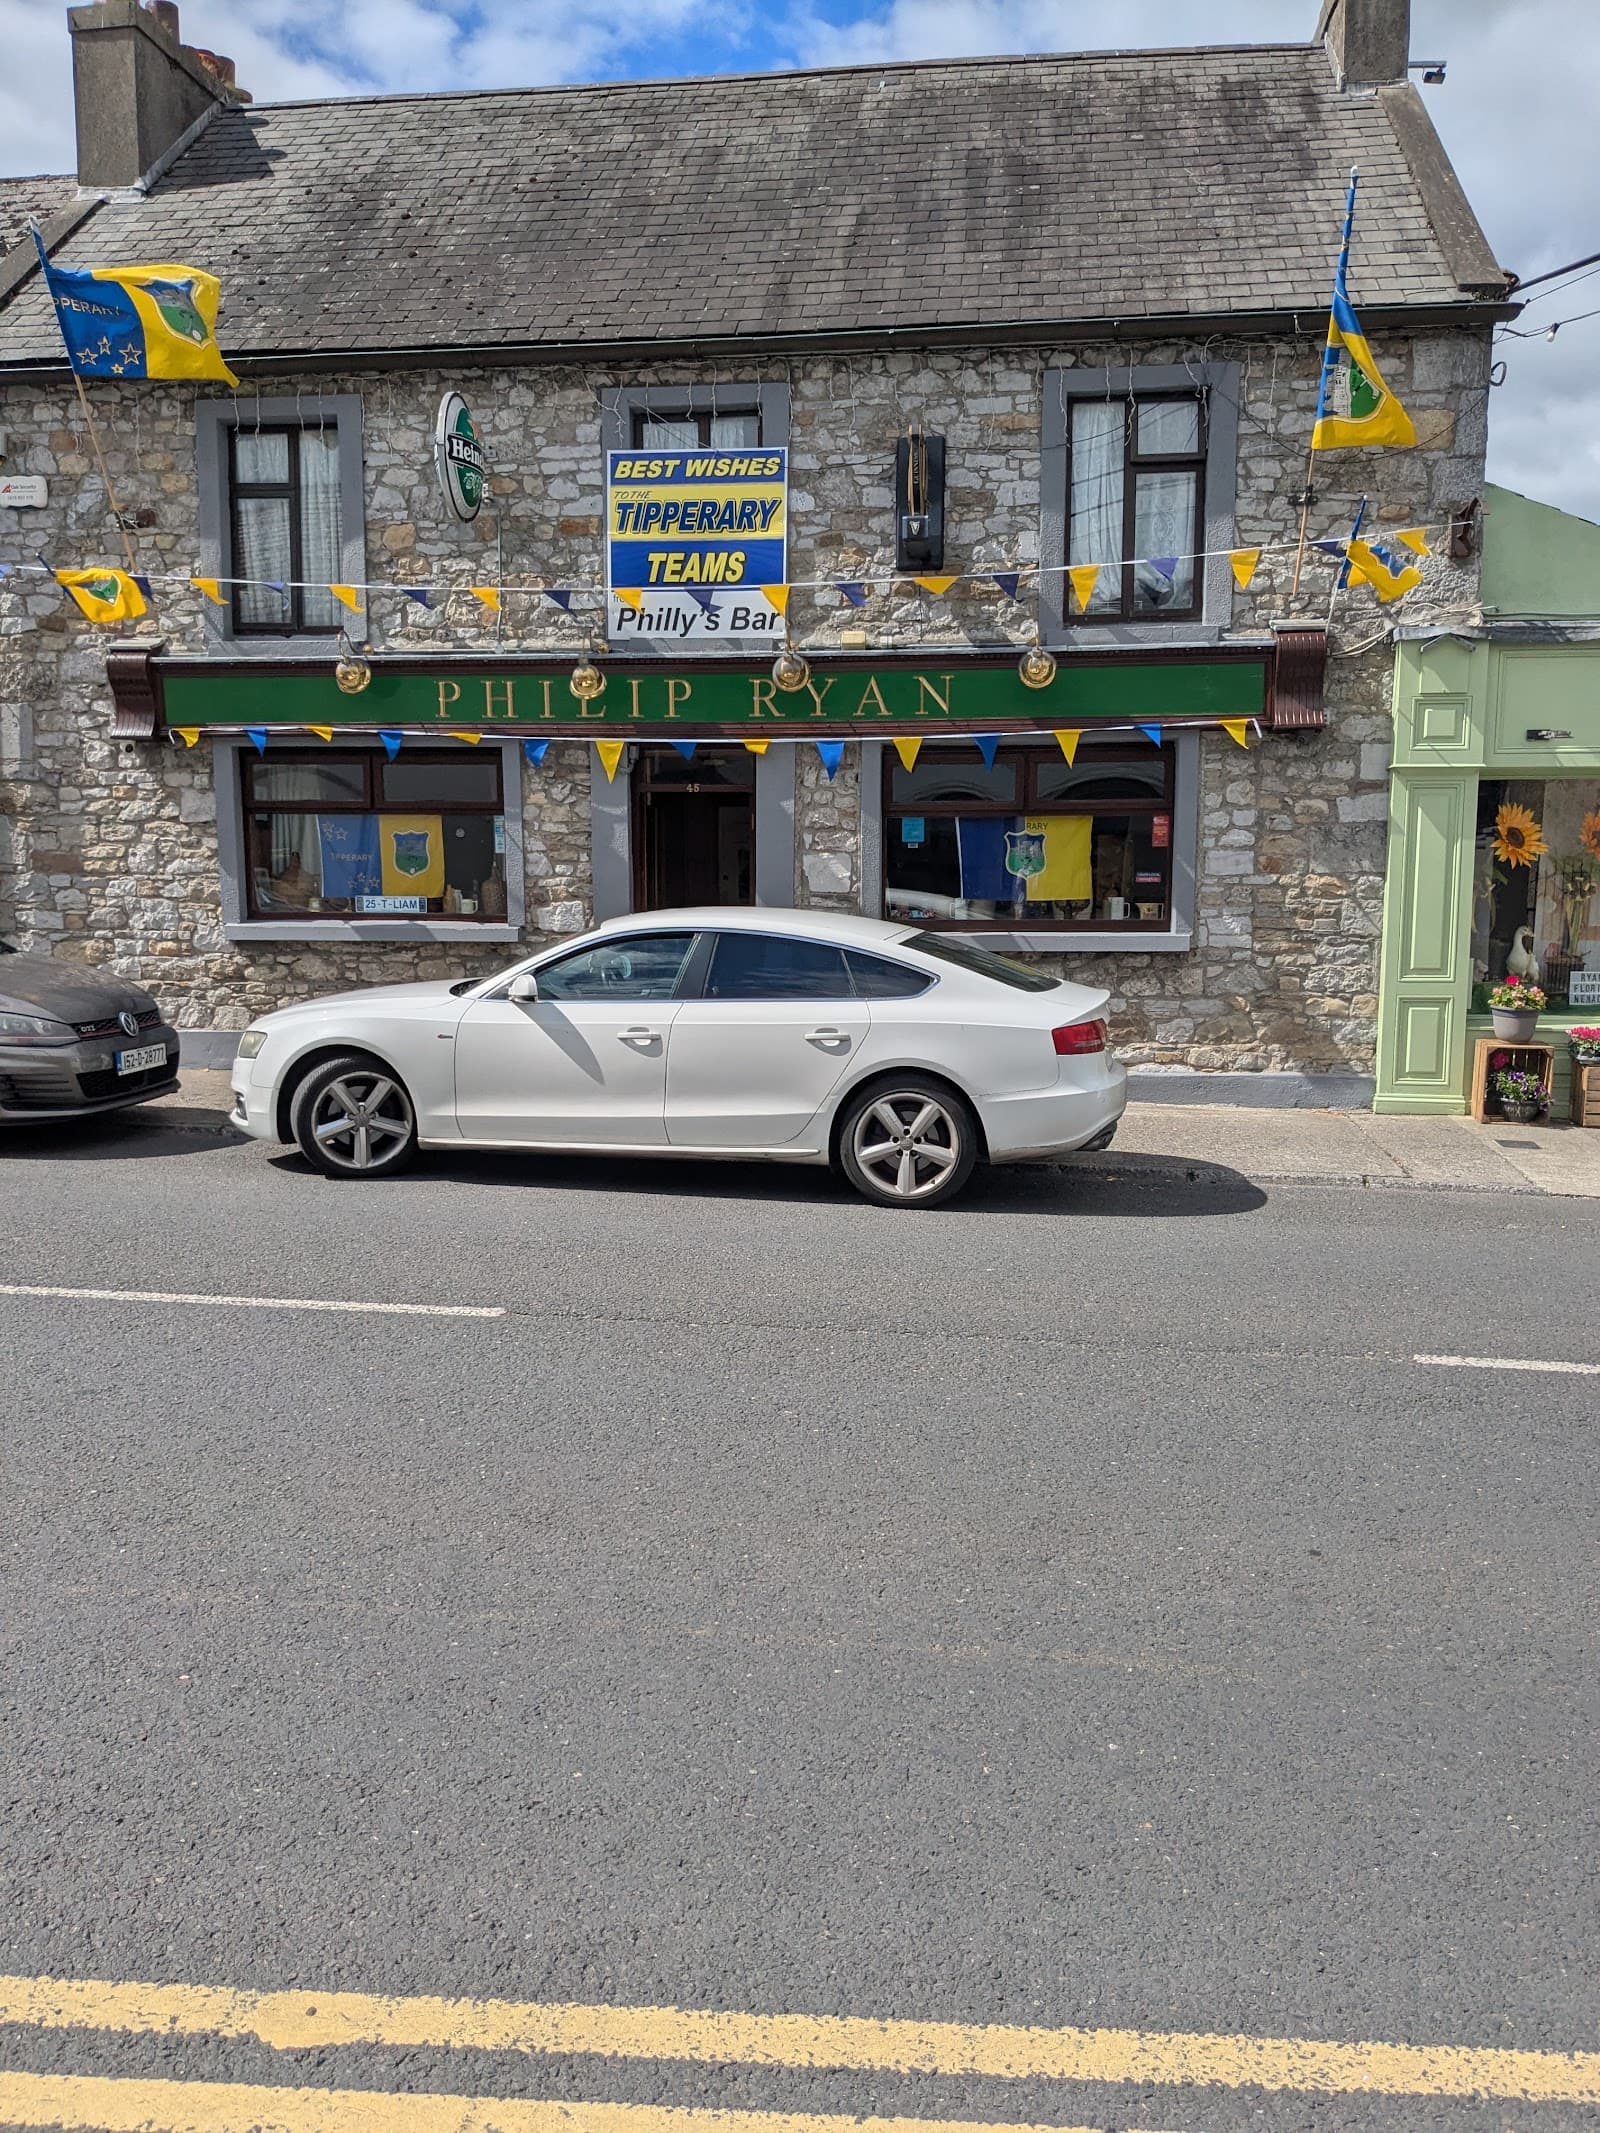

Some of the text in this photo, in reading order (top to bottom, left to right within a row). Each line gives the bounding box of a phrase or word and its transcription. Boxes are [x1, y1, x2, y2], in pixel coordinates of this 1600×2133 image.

[451, 438, 482, 467] Hein
[614, 457, 781, 479] BEST WISHES
[614, 490, 652, 500] TO THE
[616, 498, 783, 535] TIPPERARY
[647, 551, 746, 584] TEAMS
[616, 606, 780, 638] Philly's Bar
[434, 675, 954, 718] PHILIP RYAN
[686, 784, 700, 793] 45
[365, 899, 418, 909] 25-T-LIAM
[123, 1047, 164, 1070] 152-D-28777
